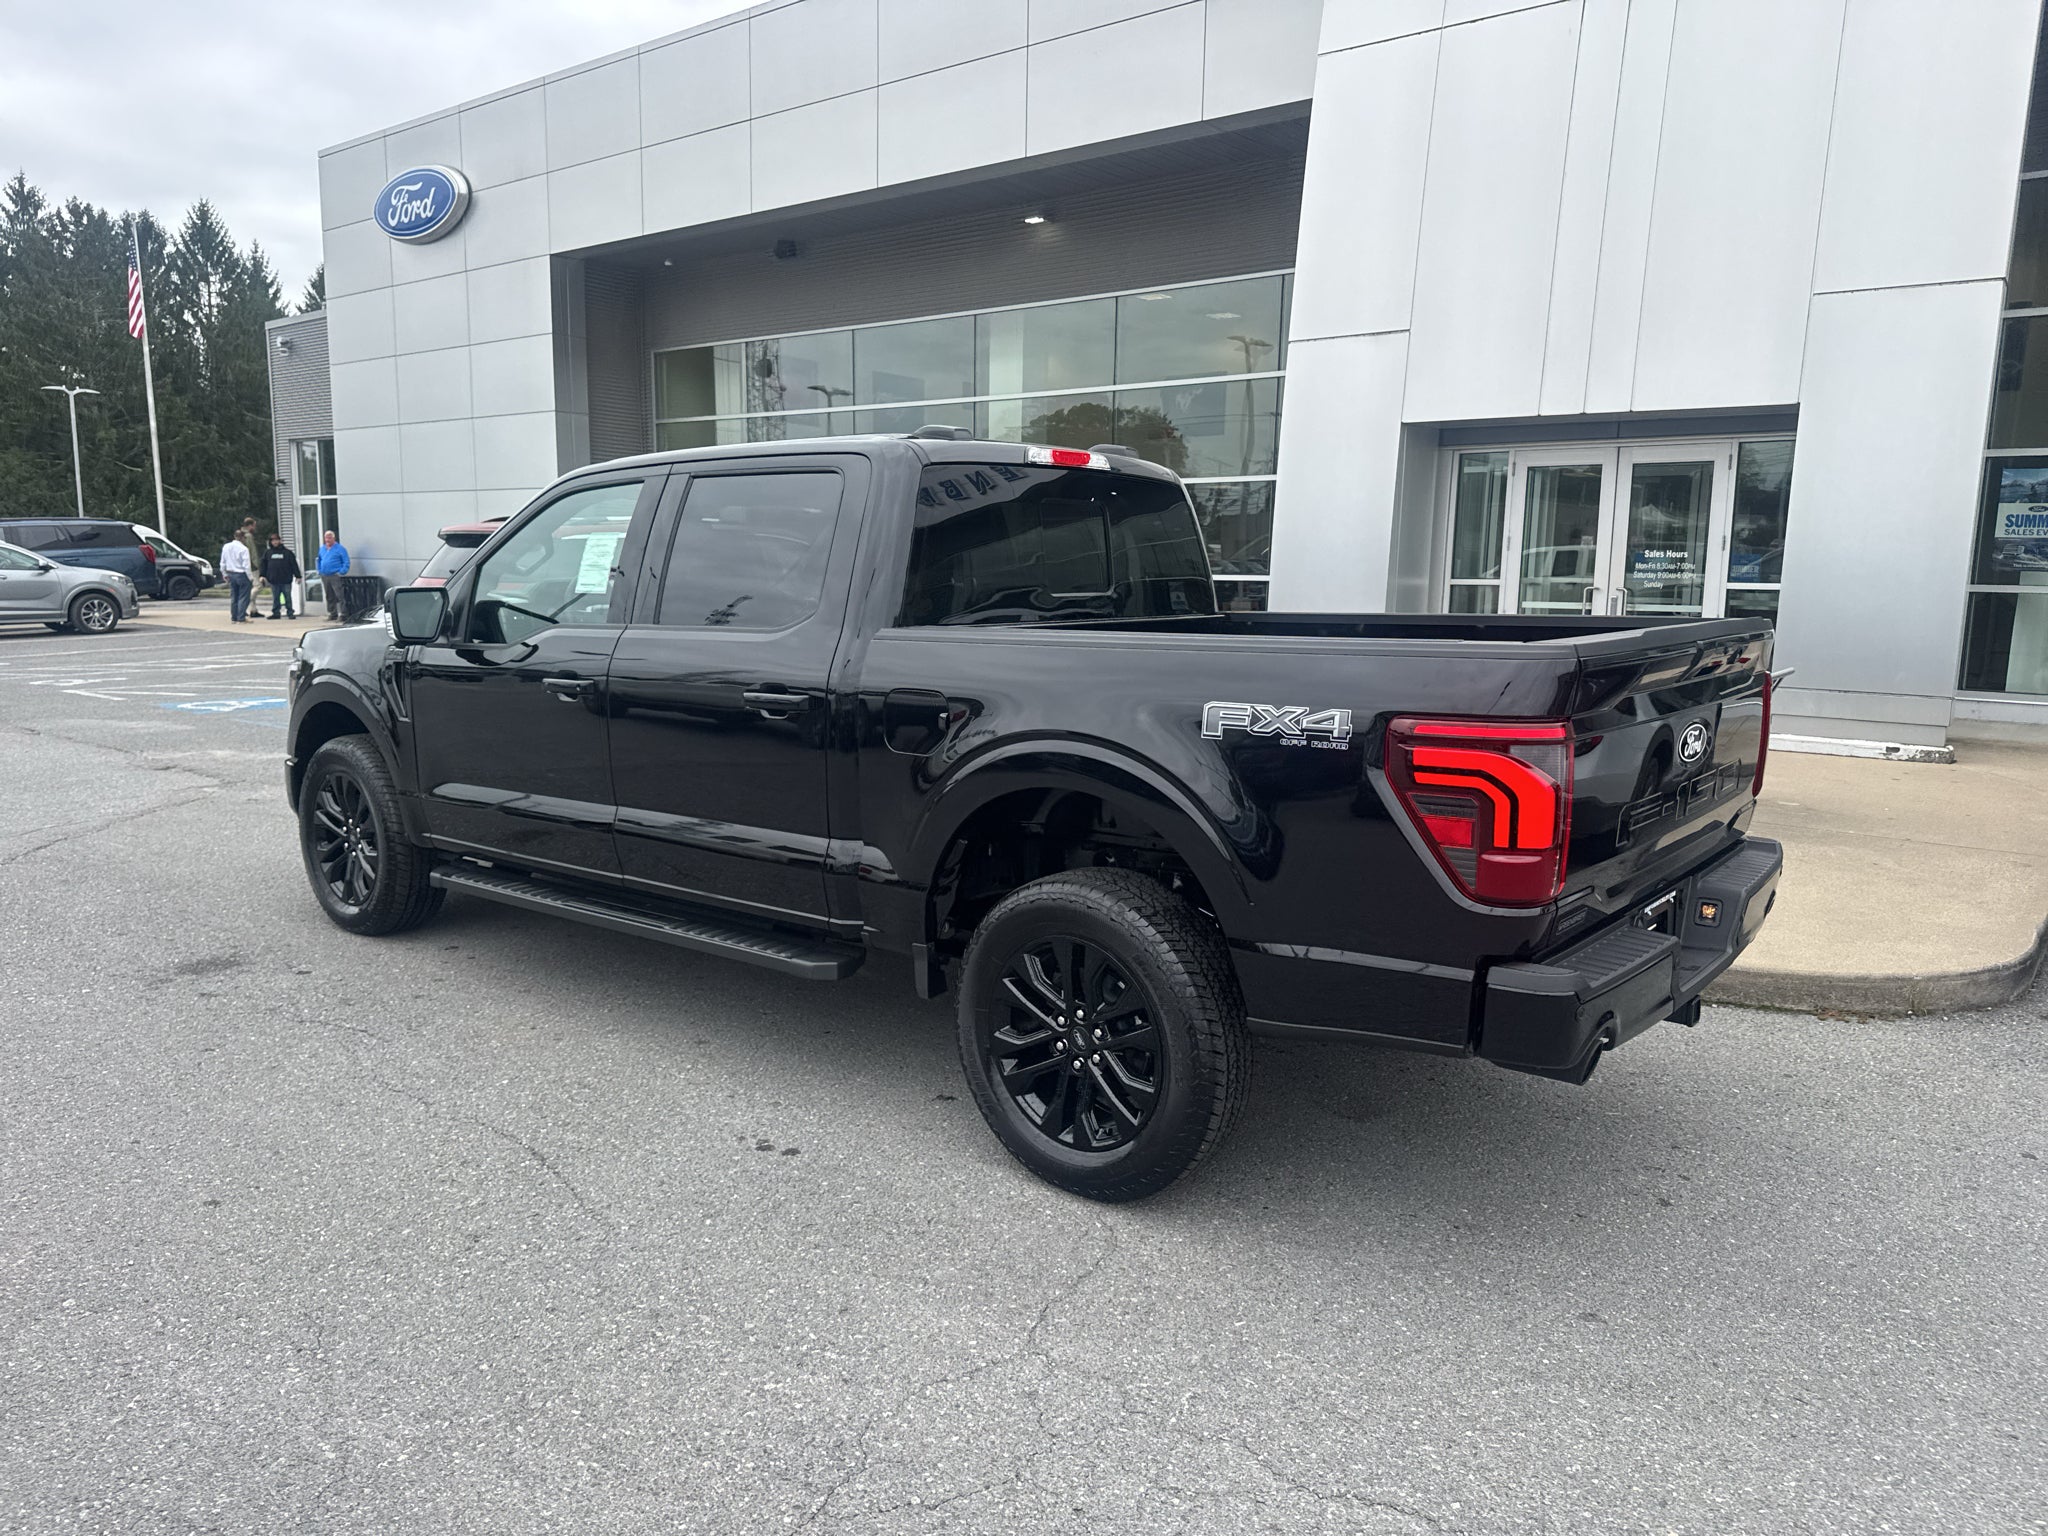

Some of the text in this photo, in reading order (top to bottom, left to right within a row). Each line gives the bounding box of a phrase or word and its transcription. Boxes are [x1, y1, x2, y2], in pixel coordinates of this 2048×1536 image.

[387, 182, 436, 227] Ford
[1644, 550, 1688, 558] Sales Hours
[1633, 571, 1657, 580] Saturday
[1643, 580, 1664, 589] Sunday
[1201, 701, 1353, 742] FX4
[1279, 738, 1307, 747] OFF
[1684, 729, 1703, 757] Ford
[1616, 758, 1742, 848] F-150
